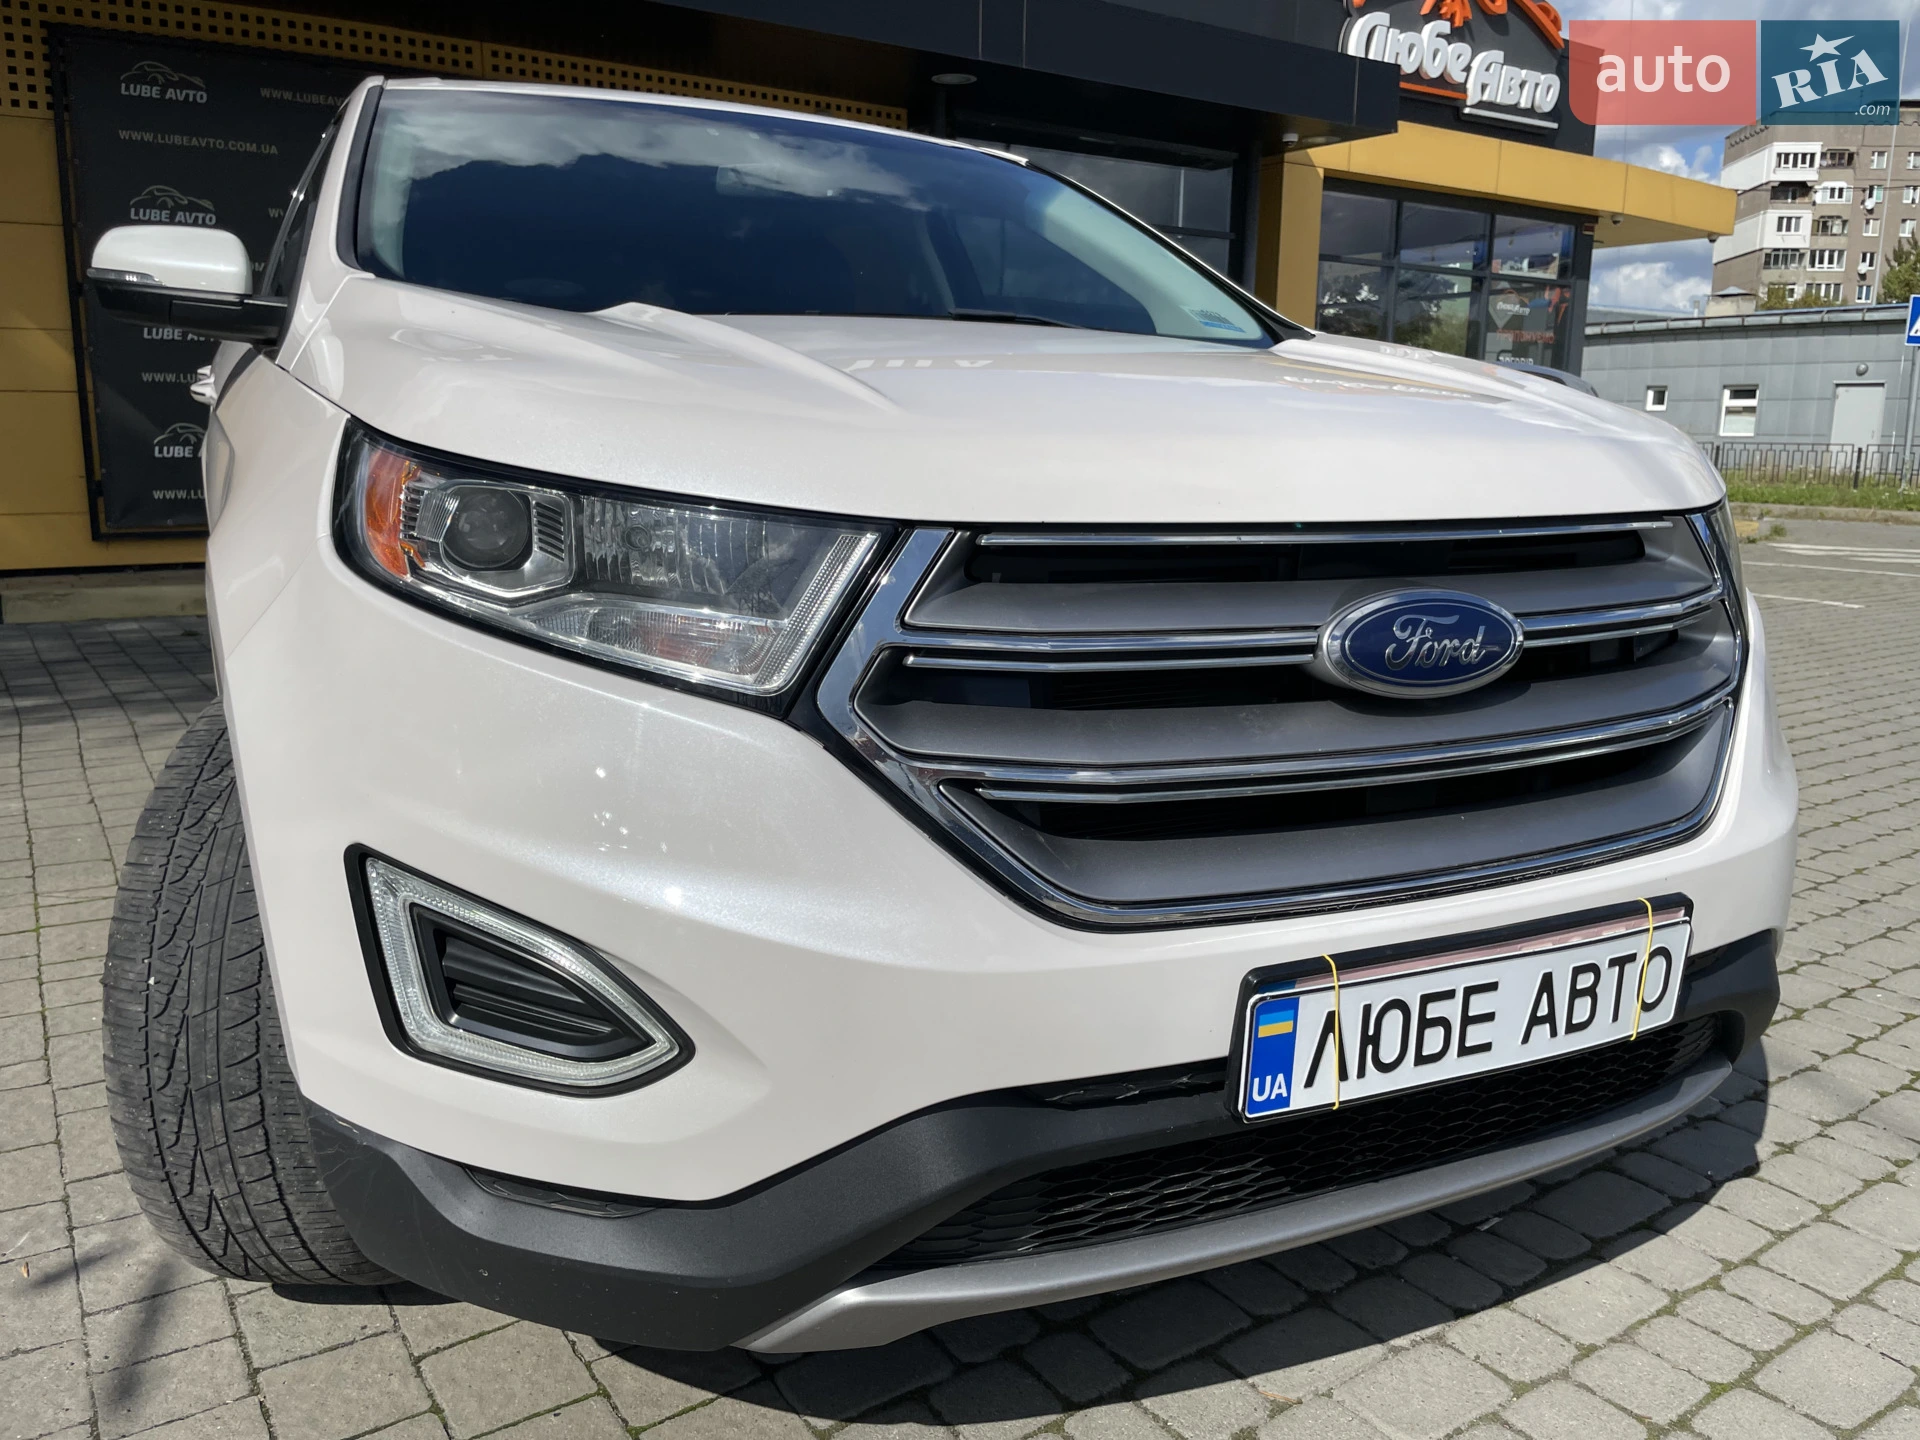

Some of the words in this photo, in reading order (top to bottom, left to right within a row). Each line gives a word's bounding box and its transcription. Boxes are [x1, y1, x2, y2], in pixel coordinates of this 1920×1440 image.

[121, 82, 160, 99] LUBE
[165, 88, 207, 104] AVTO
[260, 87, 346, 107] WWW.LUBEAV
[118, 129, 279, 155] WWW.LUBEAVTO.COM.UA
[130, 207, 170, 223] LUBE
[175, 211, 217, 226] AVTO
[143, 327, 183, 341] LUBE
[154, 446, 194, 458] LUBE
[1385, 614, 1500, 671] Ford
[1303, 980, 1500, 1089] ЛЮБЕ
[1520, 945, 1673, 1046] АВТО
[1251, 1072, 1289, 1103] UA
